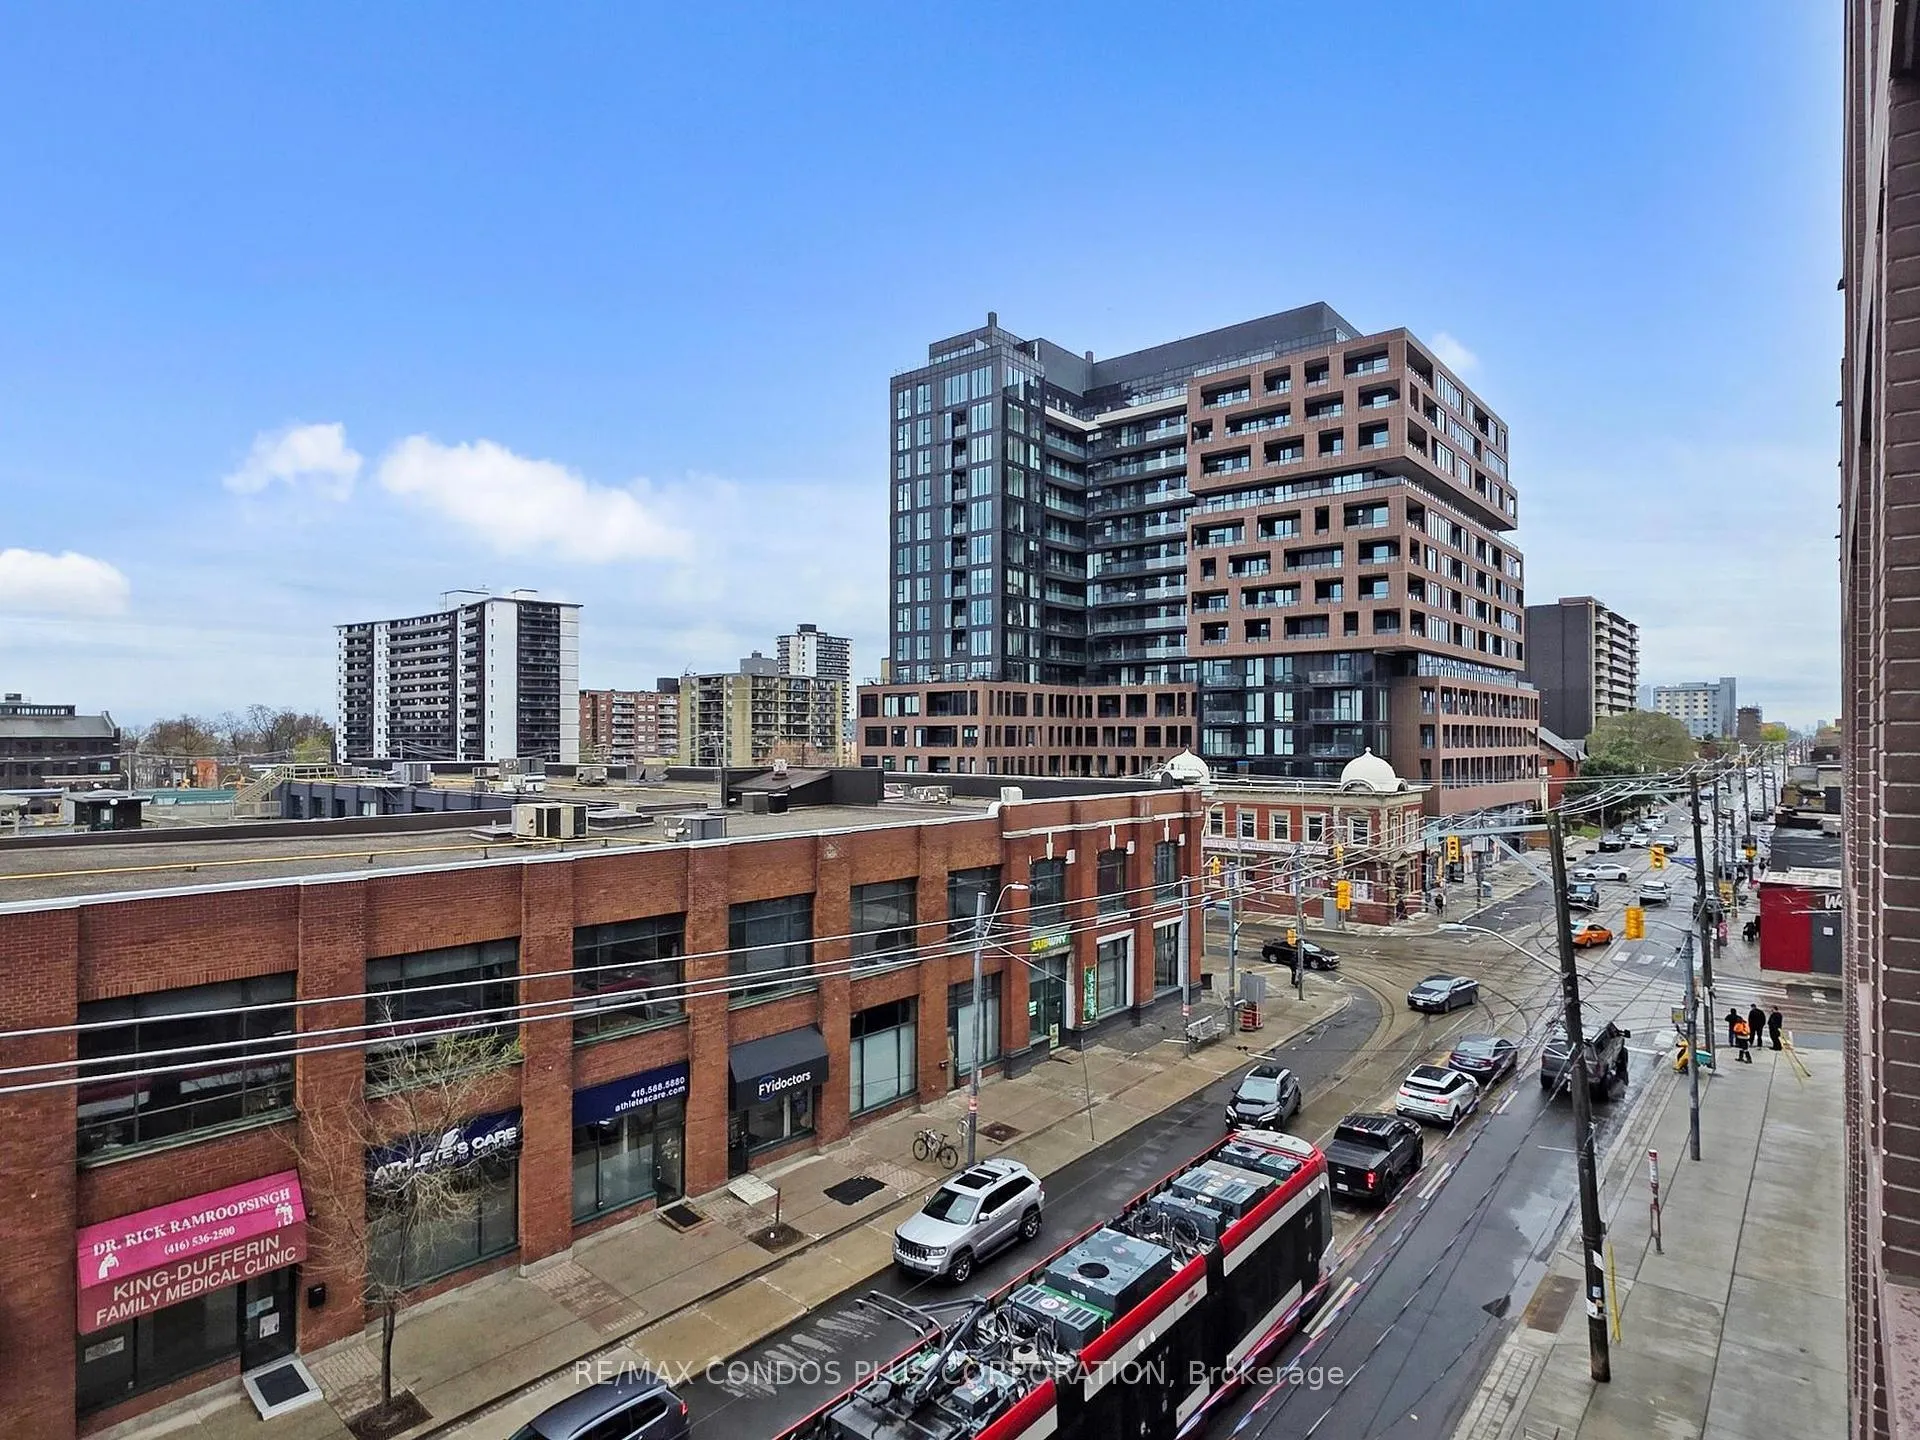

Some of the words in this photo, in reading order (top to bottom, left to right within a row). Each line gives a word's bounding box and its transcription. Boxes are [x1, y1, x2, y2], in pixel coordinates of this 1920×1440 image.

[1031, 935, 1067, 952] SUBWAY
[758, 1071, 811, 1096] FYidoctors
[615, 1085, 686, 1112] athletescare.com
[471, 1127, 517, 1149] CARE
[92, 1237, 121, 1256] DR.
[125, 1224, 167, 1246] RICK
[170, 1188, 290, 1234] RAMROOPSINGH
[163, 1239, 190, 1255] (416)
[192, 1226, 236, 1246] 536-2500
[113, 1235, 280, 1301] KING-DUFFERIN
[96, 1293, 162, 1326] FAMILY
[166, 1269, 241, 1302] MEDICAL
[244, 1247, 296, 1275] CLINIC
